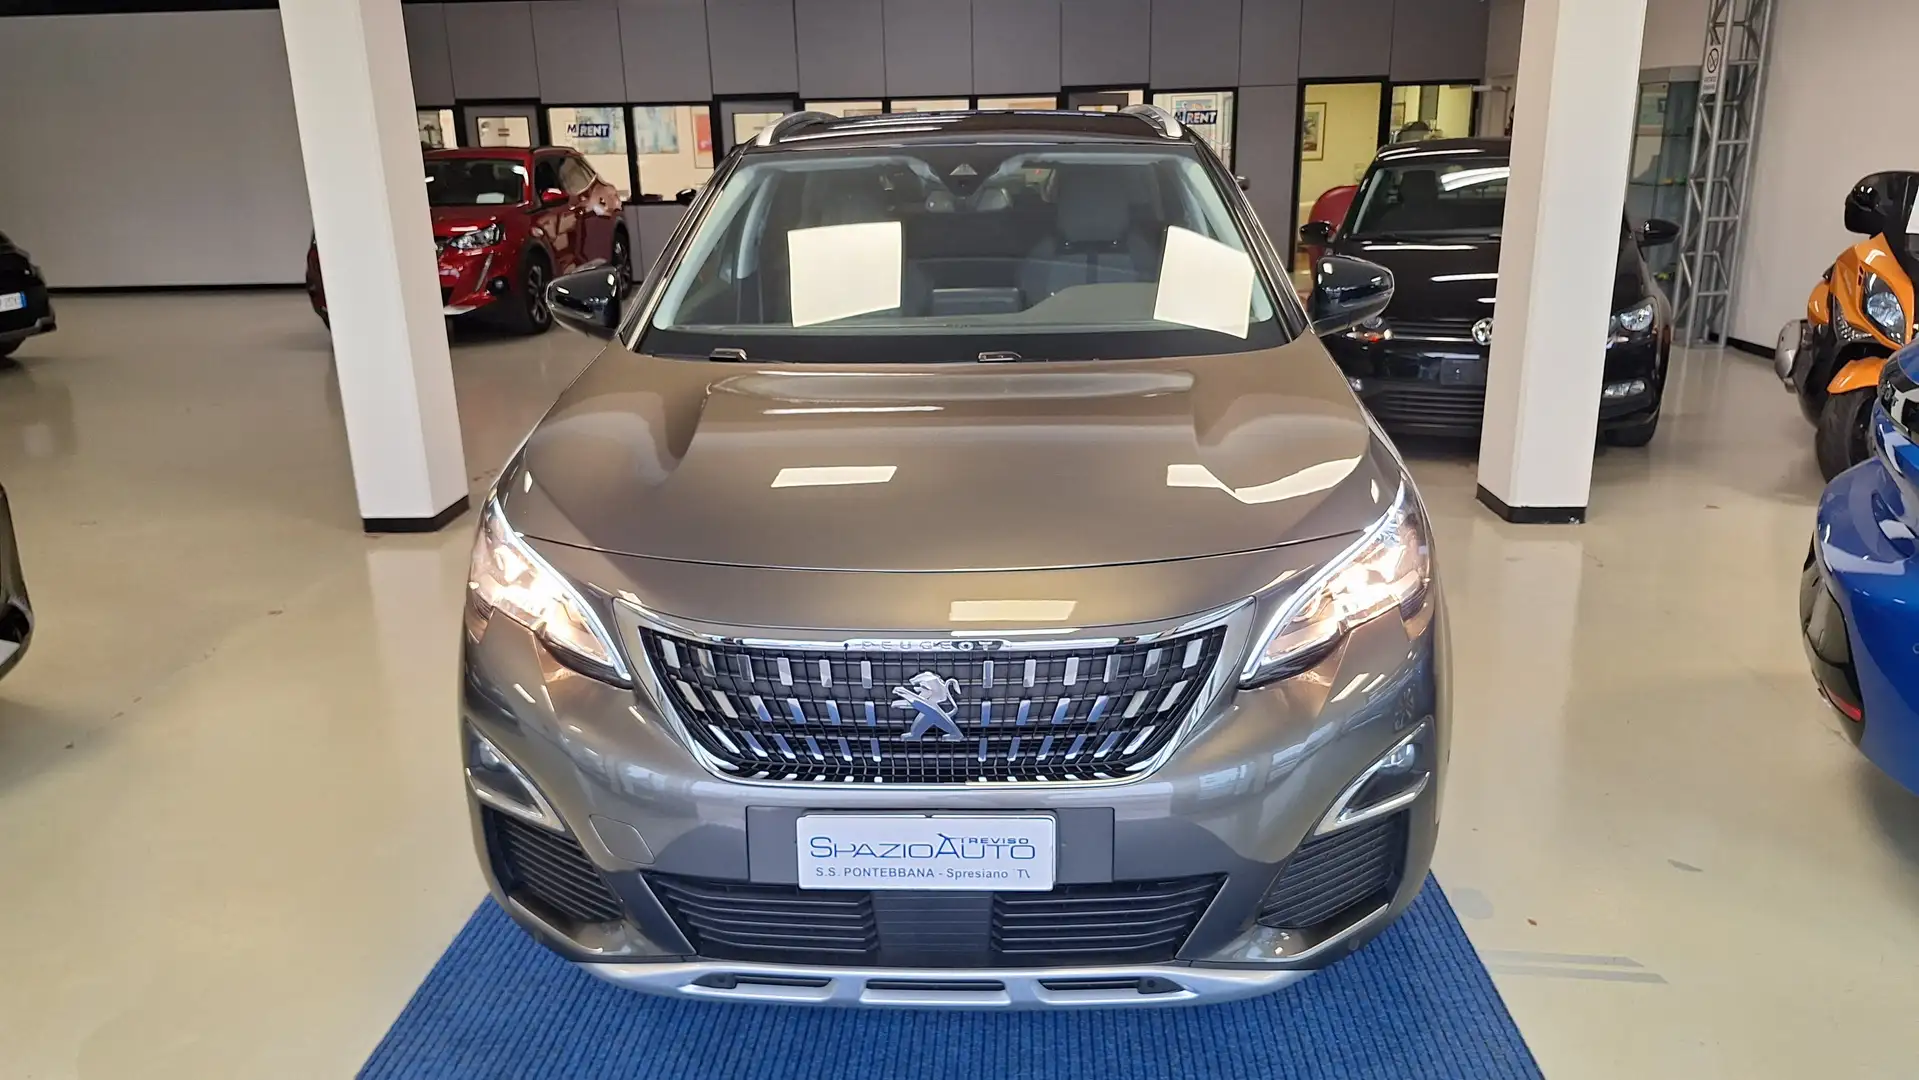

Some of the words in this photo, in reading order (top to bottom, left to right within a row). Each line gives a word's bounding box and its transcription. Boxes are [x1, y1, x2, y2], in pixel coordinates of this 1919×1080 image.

[1187, 111, 1216, 123] RENT
[580, 125, 608, 136] RENT
[861, 641, 993, 651] PEUGEOT
[952, 836, 1029, 845] TREVISO
[816, 867, 841, 877] S.S.
[844, 867, 935, 878] PONTEBBANA
[946, 868, 1009, 880] Spresiano
